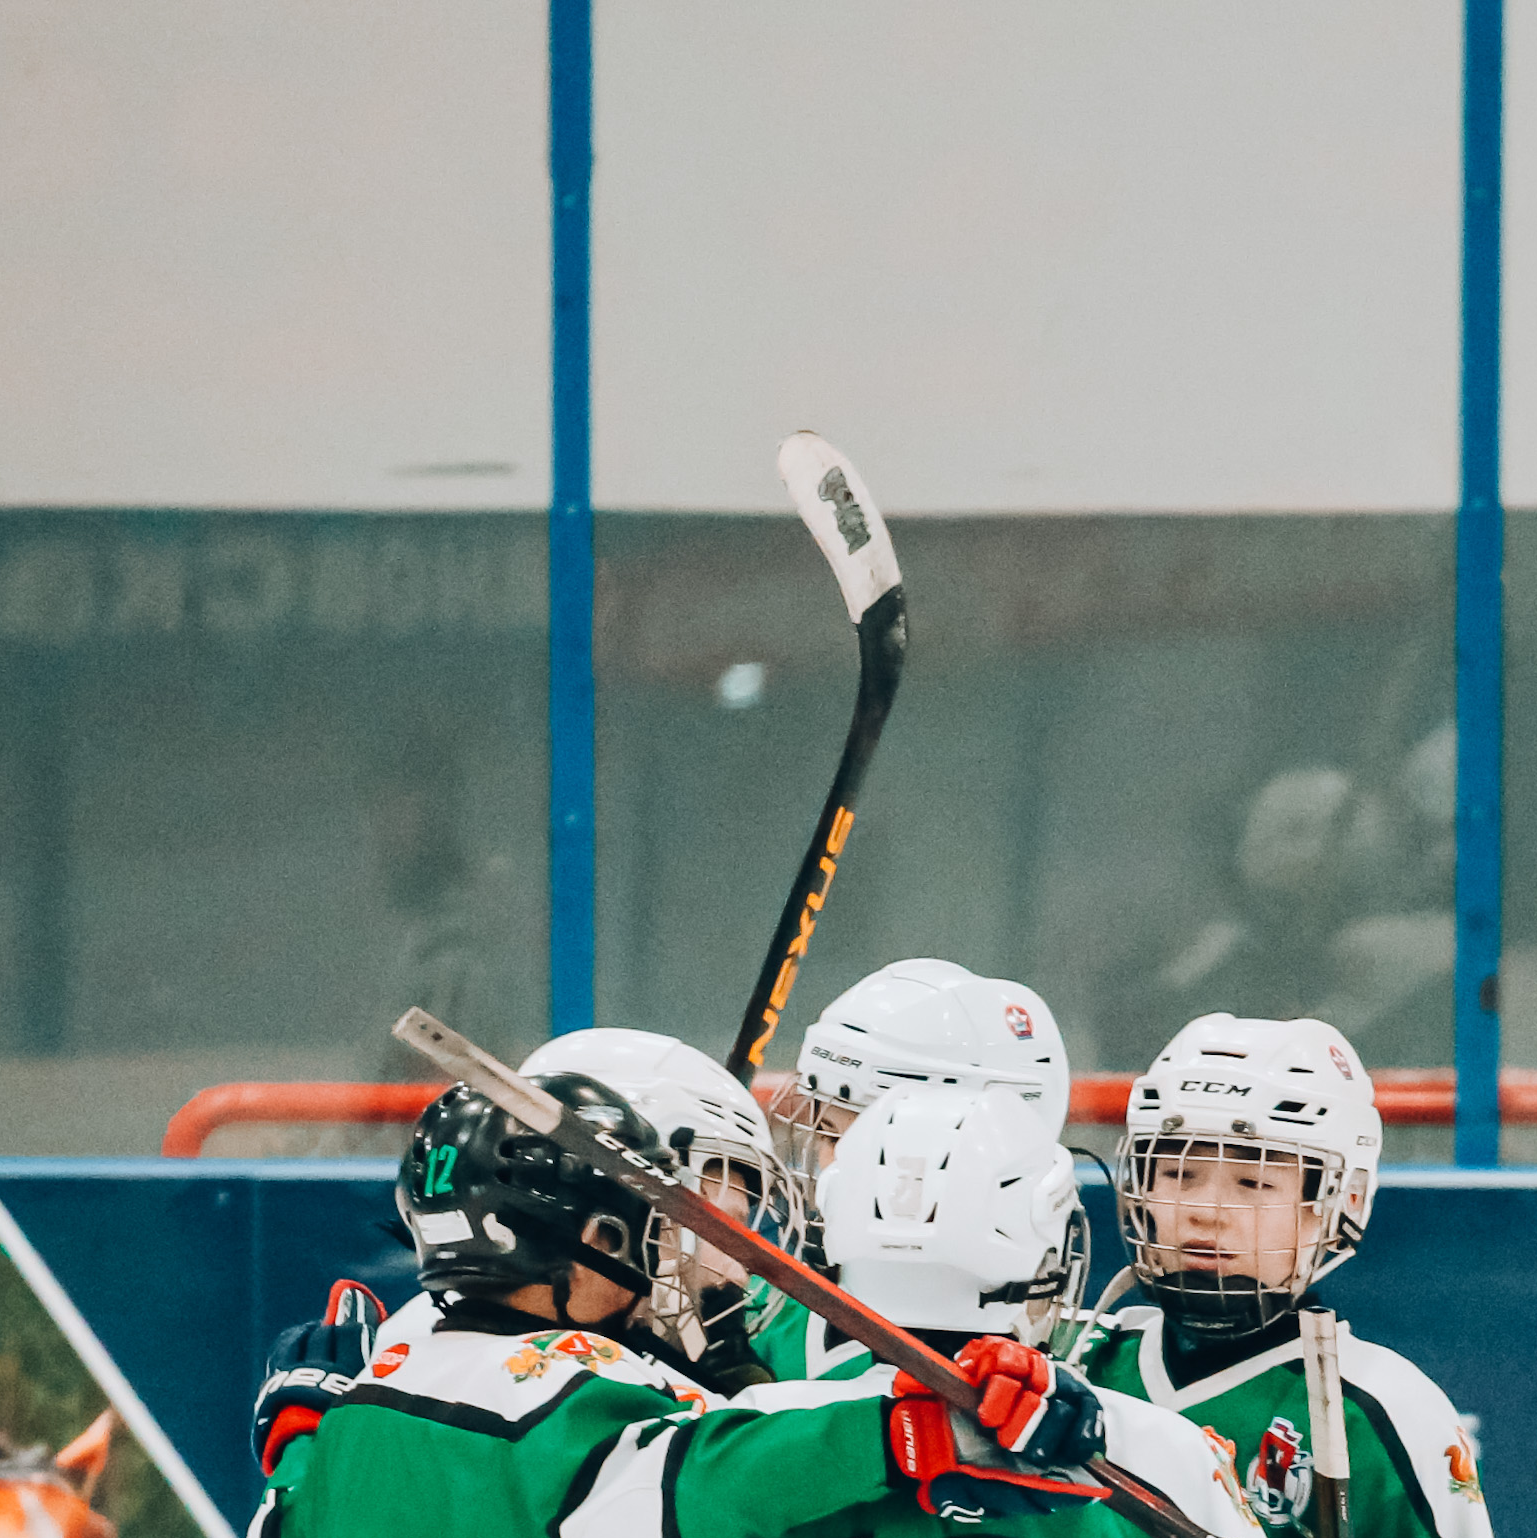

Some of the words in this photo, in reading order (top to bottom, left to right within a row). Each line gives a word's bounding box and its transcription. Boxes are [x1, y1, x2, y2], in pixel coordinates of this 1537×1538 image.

[748, 806, 855, 1067] NEXUS
[810, 1046, 863, 1069] BAUER
[1180, 1080, 1252, 1097] CCM
[424, 1144, 458, 1198] 12
